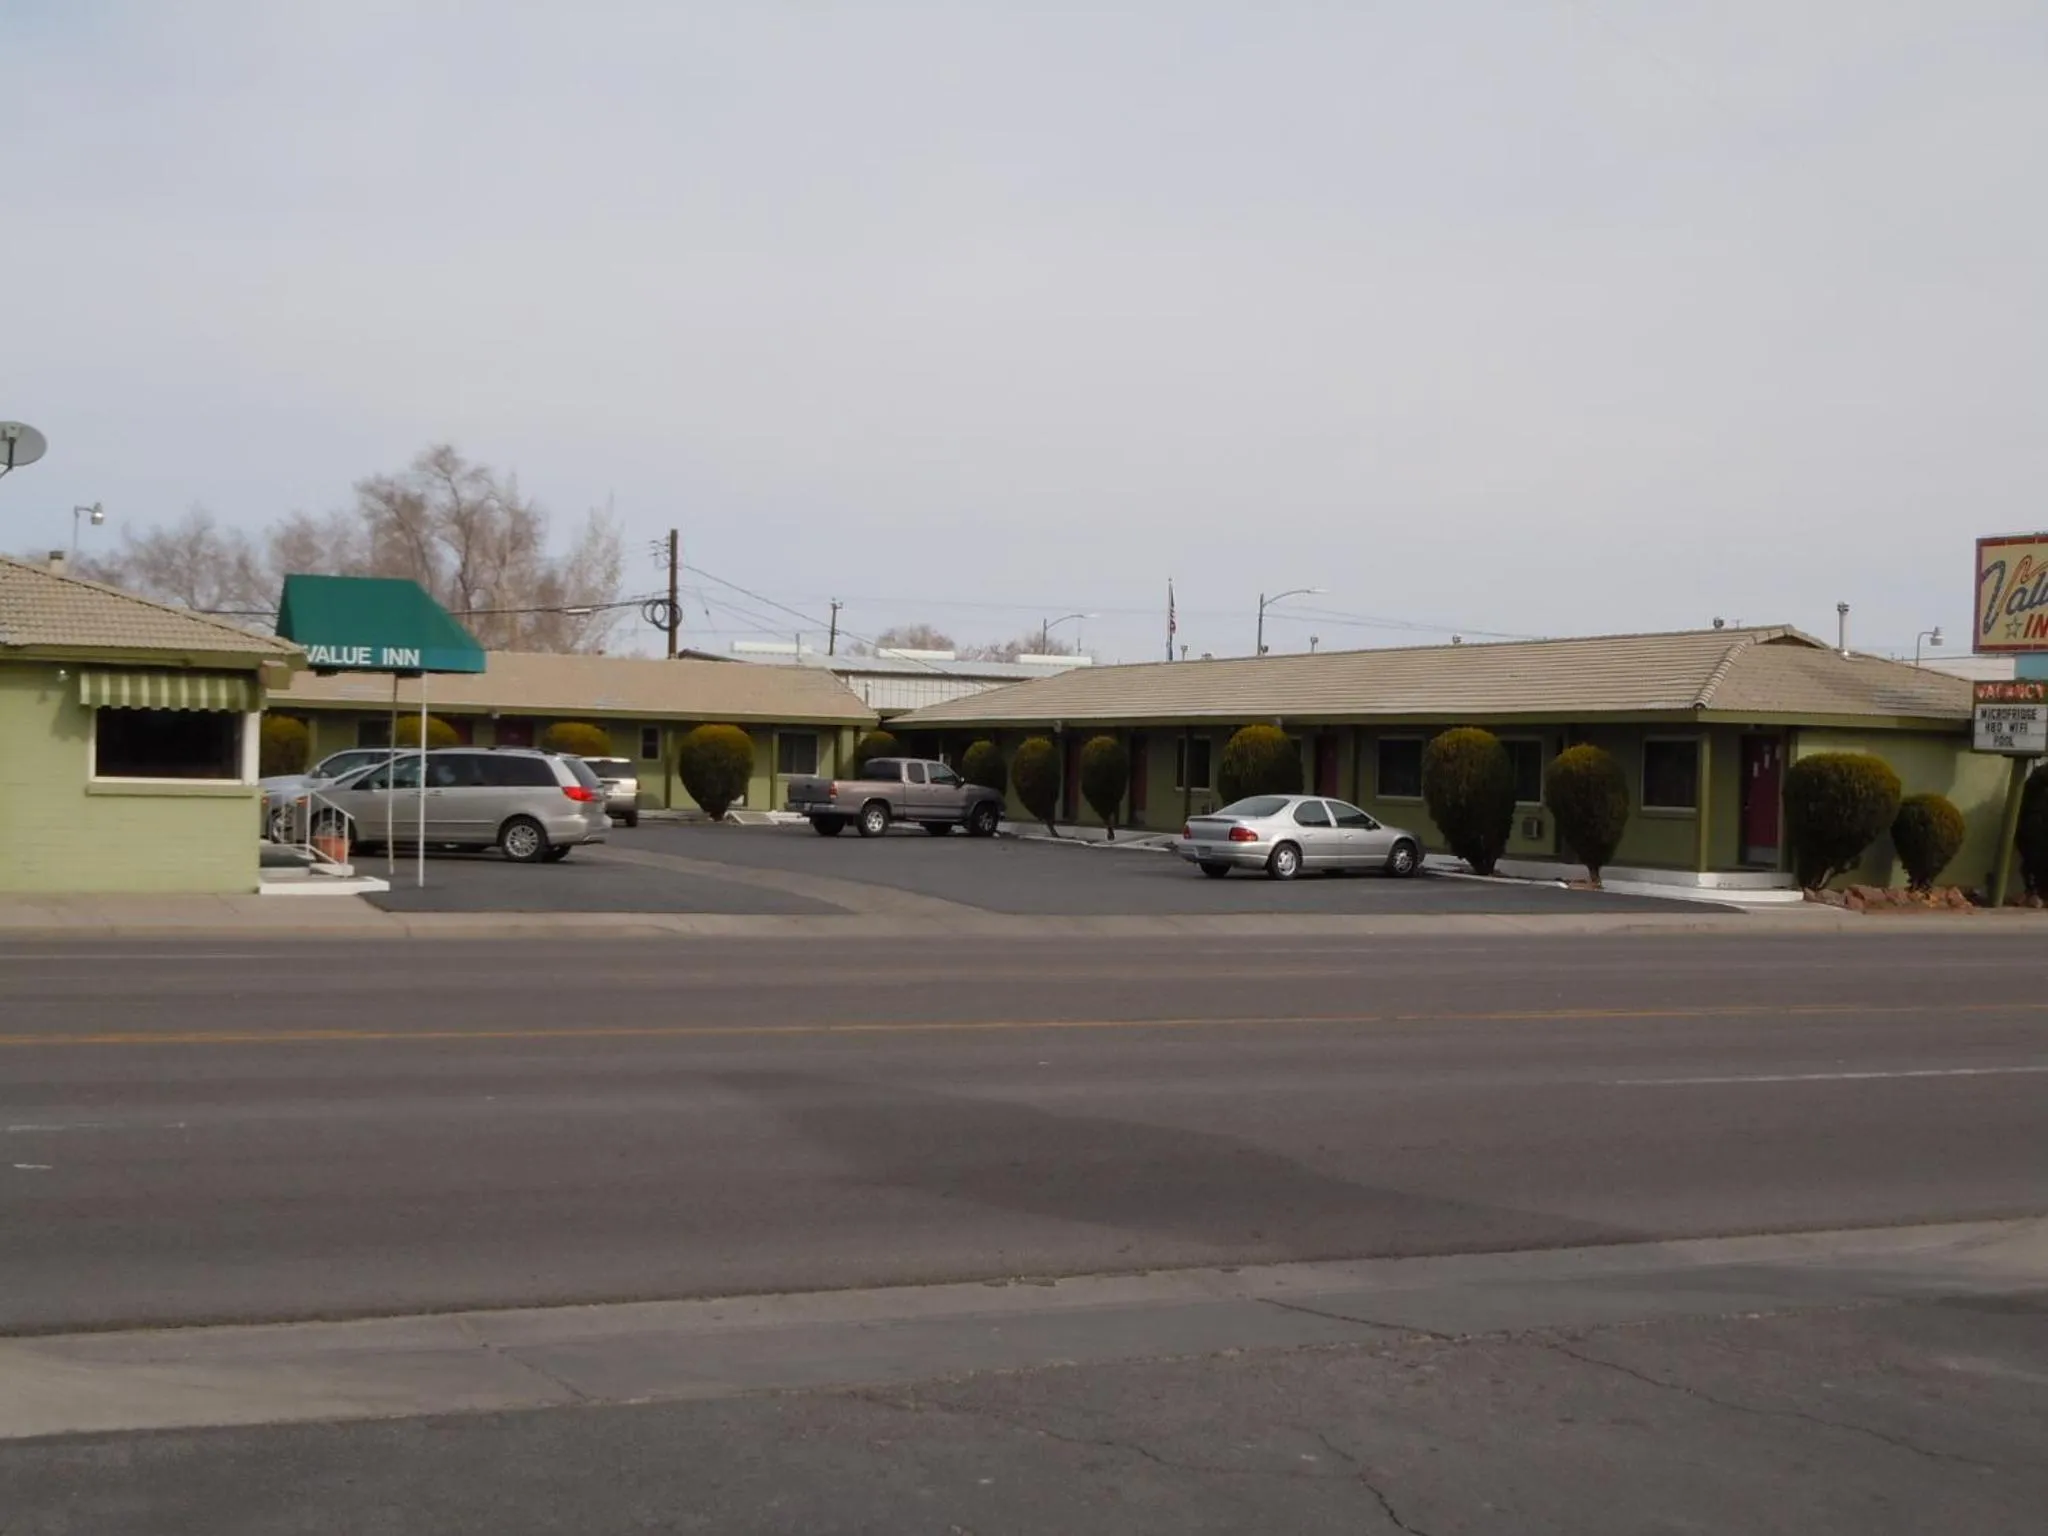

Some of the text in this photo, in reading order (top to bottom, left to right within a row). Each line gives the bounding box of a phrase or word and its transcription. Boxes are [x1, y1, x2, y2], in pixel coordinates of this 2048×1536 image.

[304, 645, 420, 666] VALUE INN
[1977, 683, 2044, 699] VACANCY
